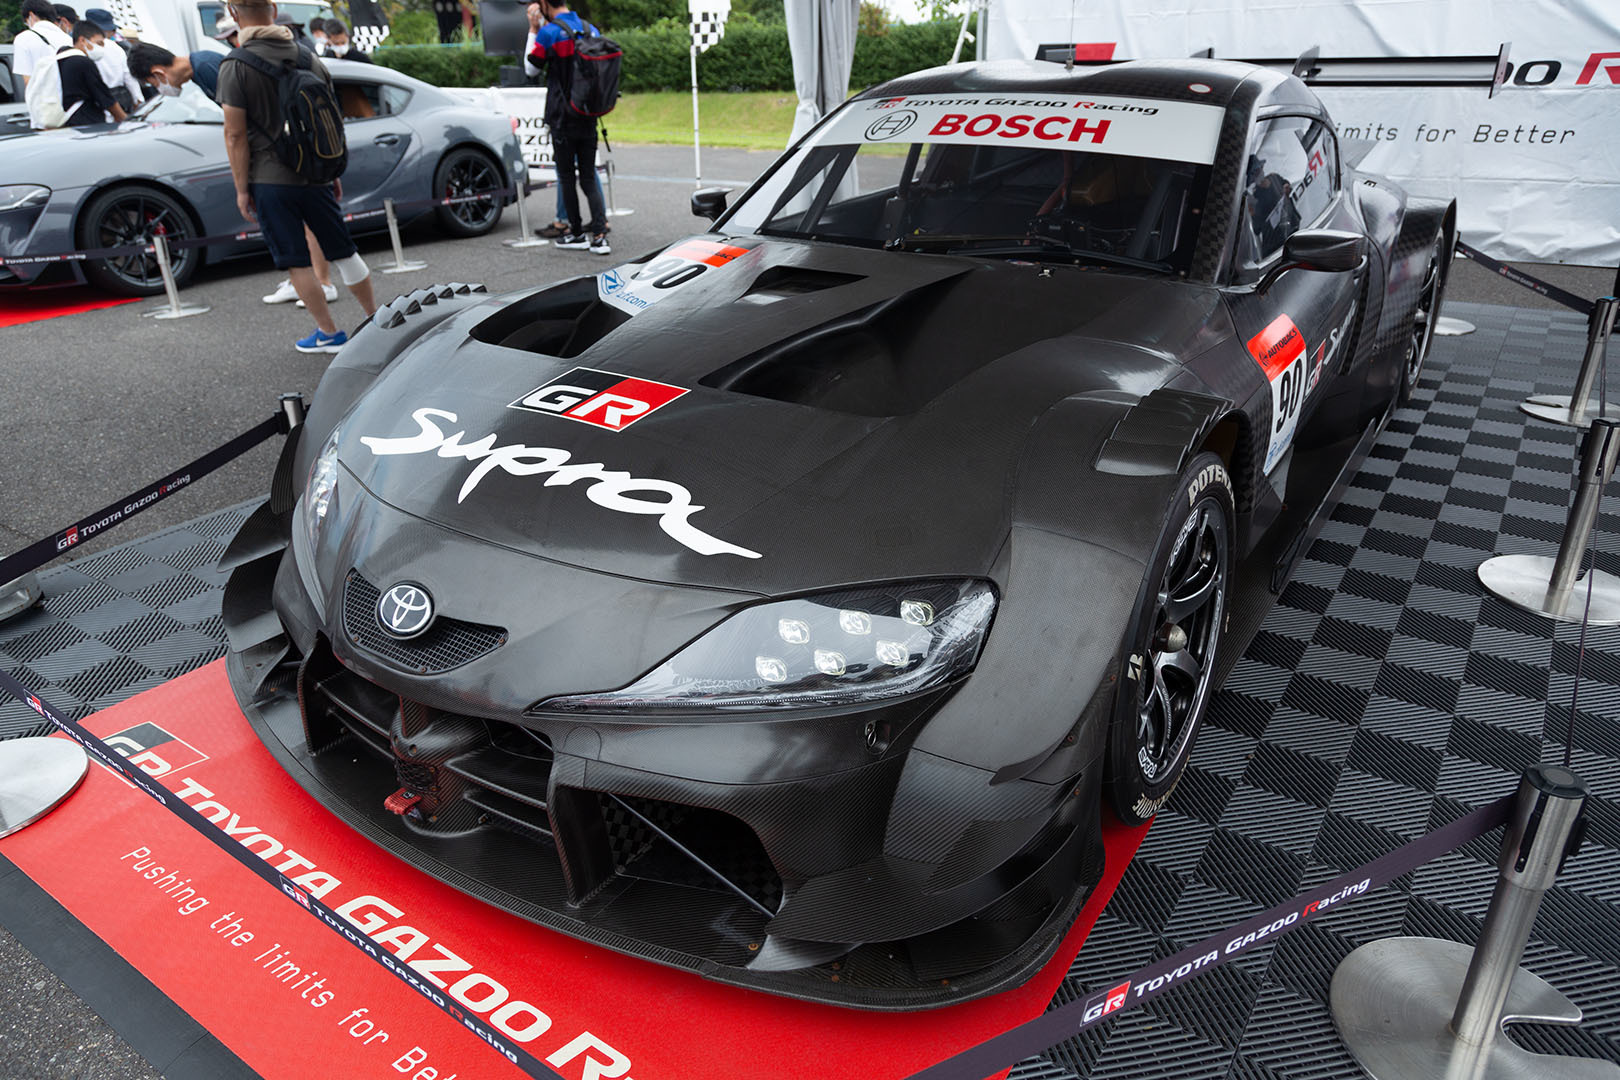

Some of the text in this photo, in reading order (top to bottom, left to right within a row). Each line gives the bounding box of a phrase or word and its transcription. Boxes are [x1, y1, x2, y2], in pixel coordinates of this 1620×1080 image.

[904, 99, 978, 108] TOYOTA
[984, 98, 1068, 109] GAZOO
[1073, 100, 1160, 117] Racing
[928, 113, 1112, 145] BOSCH
[1415, 123, 1456, 143] for
[1472, 124, 1576, 145] Better
[630, 258, 708, 289] 90
[1267, 327, 1299, 359] AUTOBACS
[522, 384, 651, 427] GR
[1276, 358, 1303, 434] 90
[57, 473, 191, 550] GR TOYOTA GAZOO Racing
[360, 407, 763, 560] Supra
[26, 697, 45, 716] GR
[44, 709, 84, 744] TOYOTA
[174, 777, 342, 900] TOYOTA
[334, 894, 553, 1043] GAZOO
[120, 846, 457, 1080] Pushing the limits for Be
[282, 883, 518, 1064] GR TOYOTA GAZOO Racing
[1083, 877, 1371, 1024] GR TOYOTA GAZOO Racing
